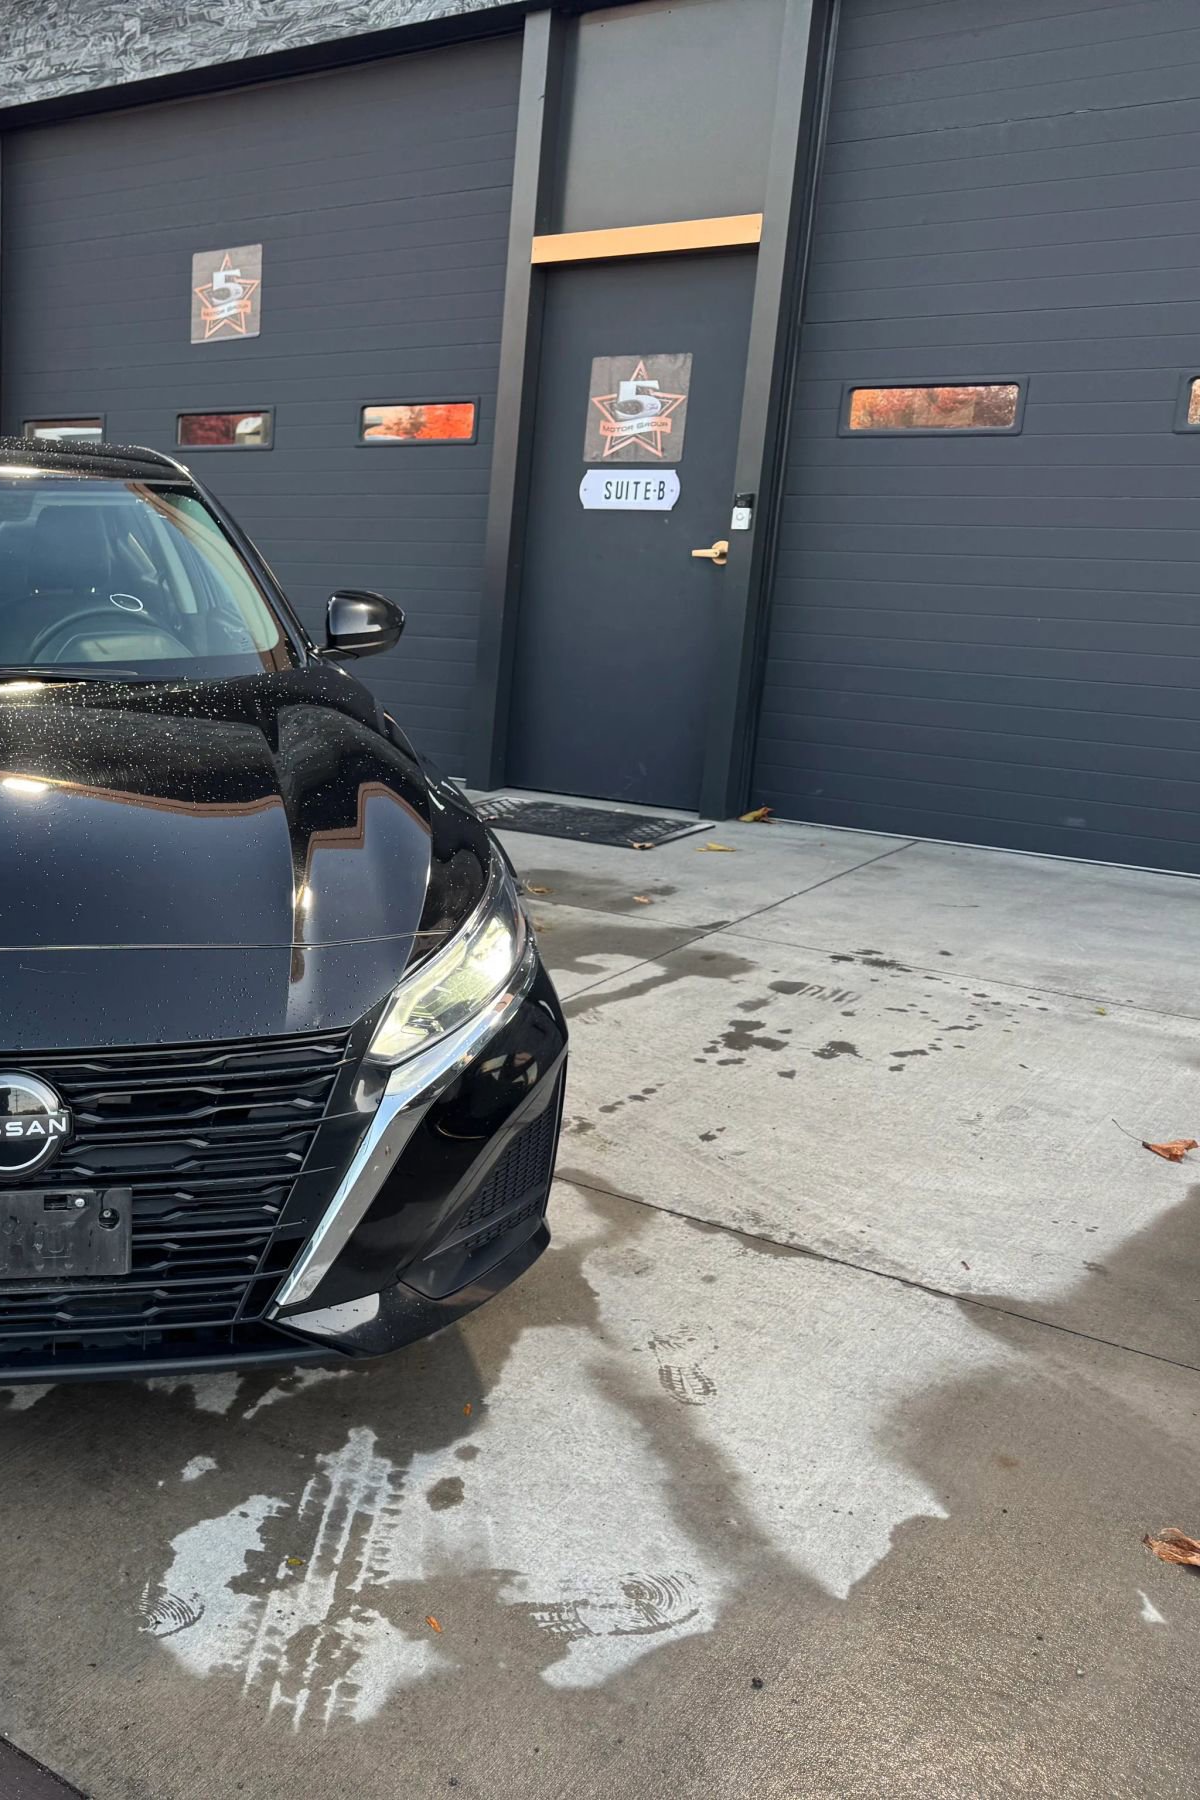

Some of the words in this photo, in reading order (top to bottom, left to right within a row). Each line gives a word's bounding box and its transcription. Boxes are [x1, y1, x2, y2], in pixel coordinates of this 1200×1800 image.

[211, 268, 243, 305] 5
[616, 380, 661, 419] 5
[602, 423, 634, 433] MOTOR
